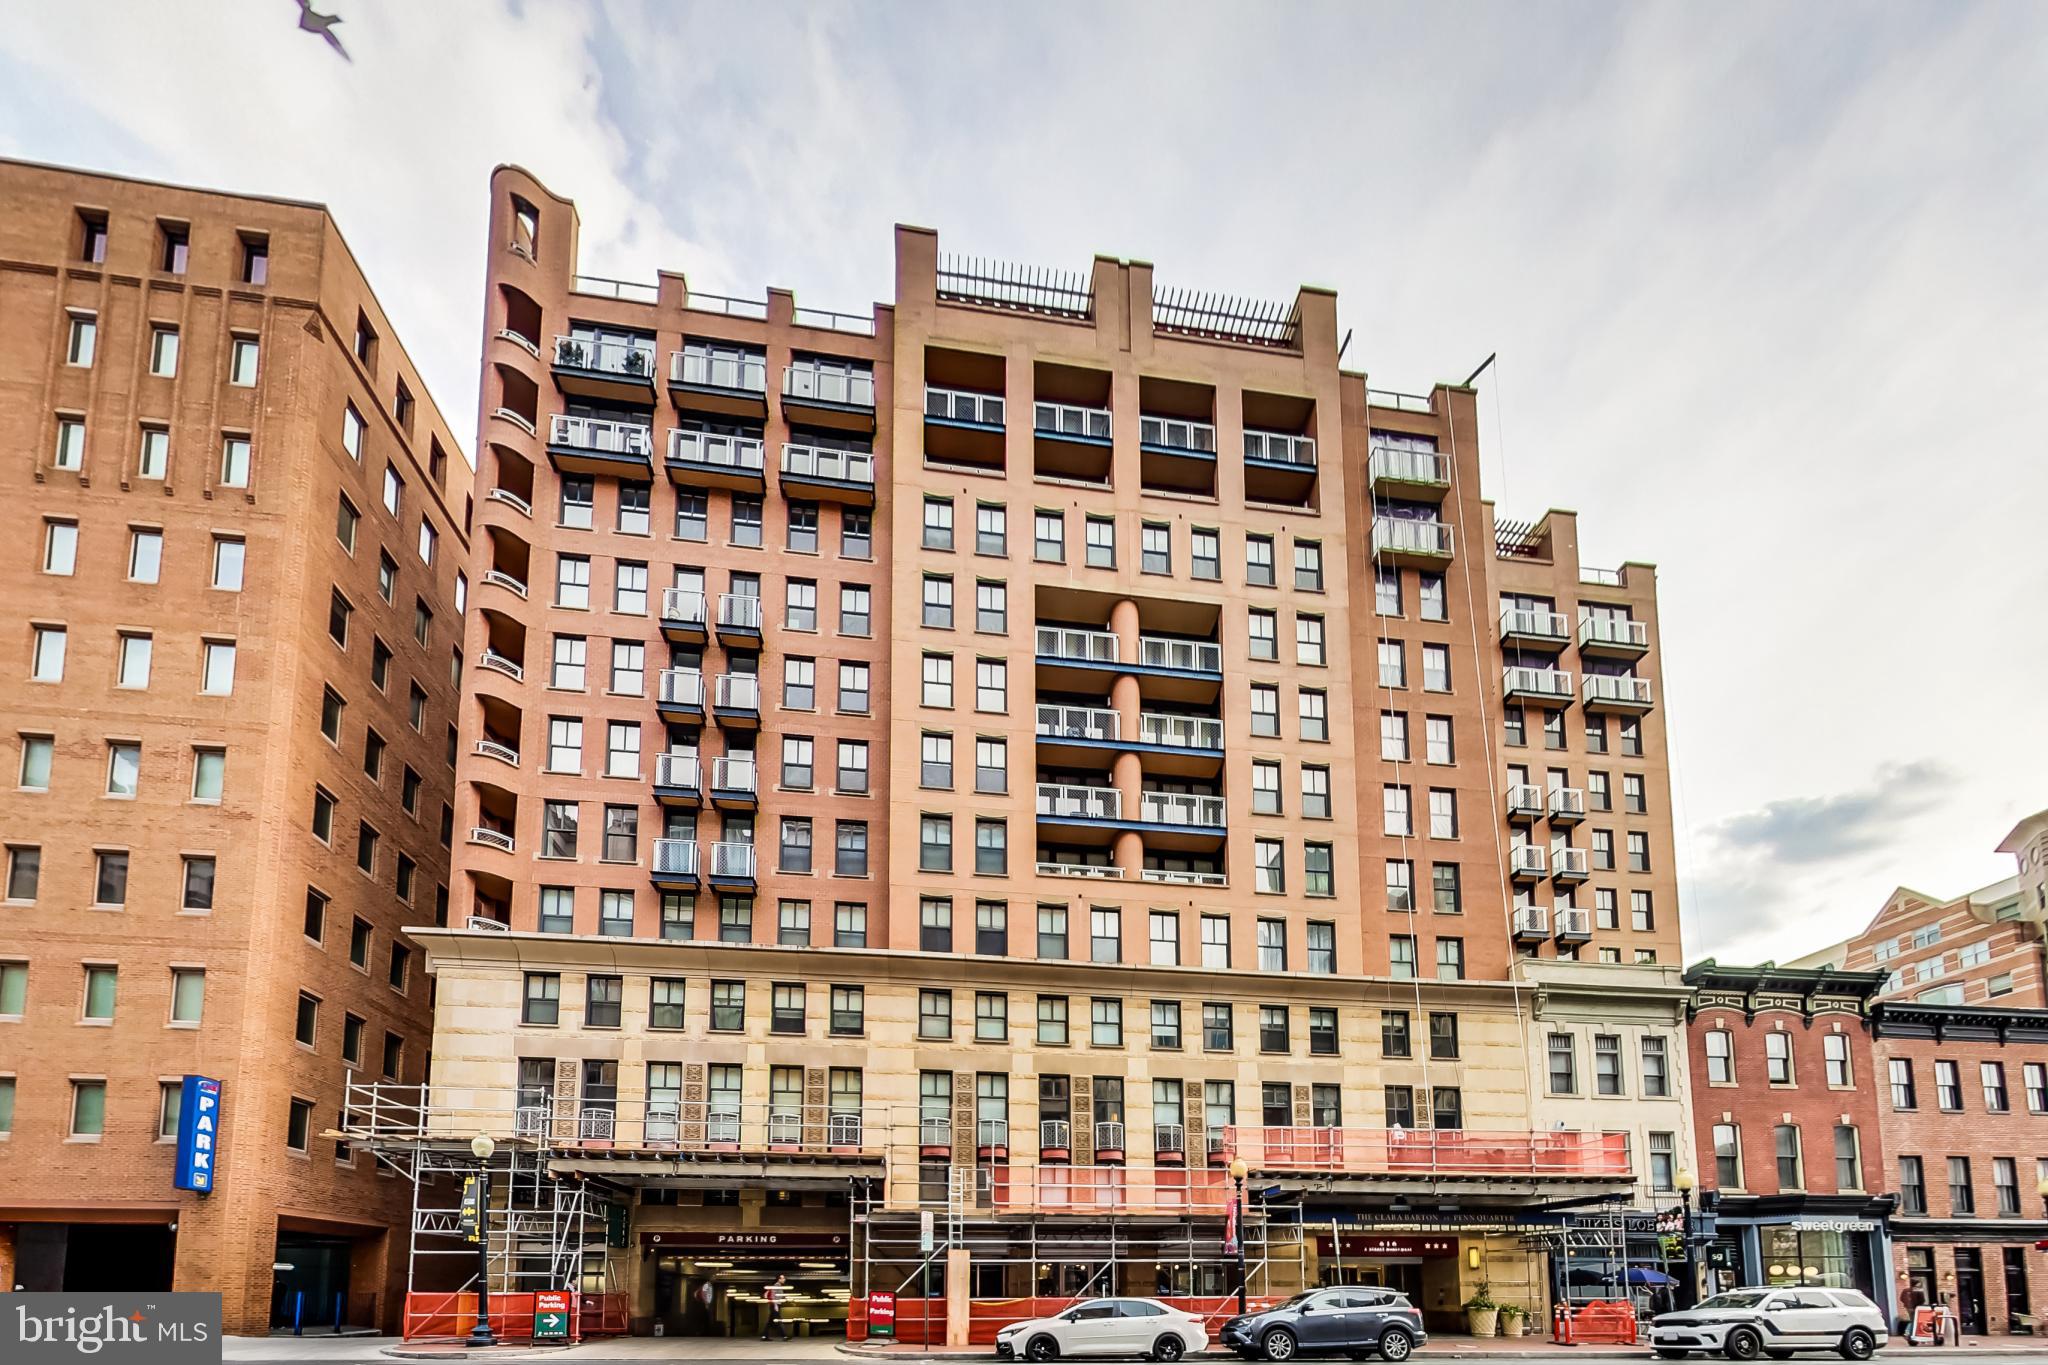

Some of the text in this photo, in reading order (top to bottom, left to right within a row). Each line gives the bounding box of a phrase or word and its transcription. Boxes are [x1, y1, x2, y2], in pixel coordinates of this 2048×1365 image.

[194, 1096, 215, 1169] PARK
[1356, 1213, 1372, 1221] THE
[1374, 1213, 1402, 1221] CLARA
[1404, 1213, 1439, 1221] BARTON
[1791, 1221, 1875, 1233] sweetgreen
[718, 1235, 778, 1243] PARKING
[1711, 1253, 1724, 1261] sg
[870, 1308, 894, 1316] Parking
